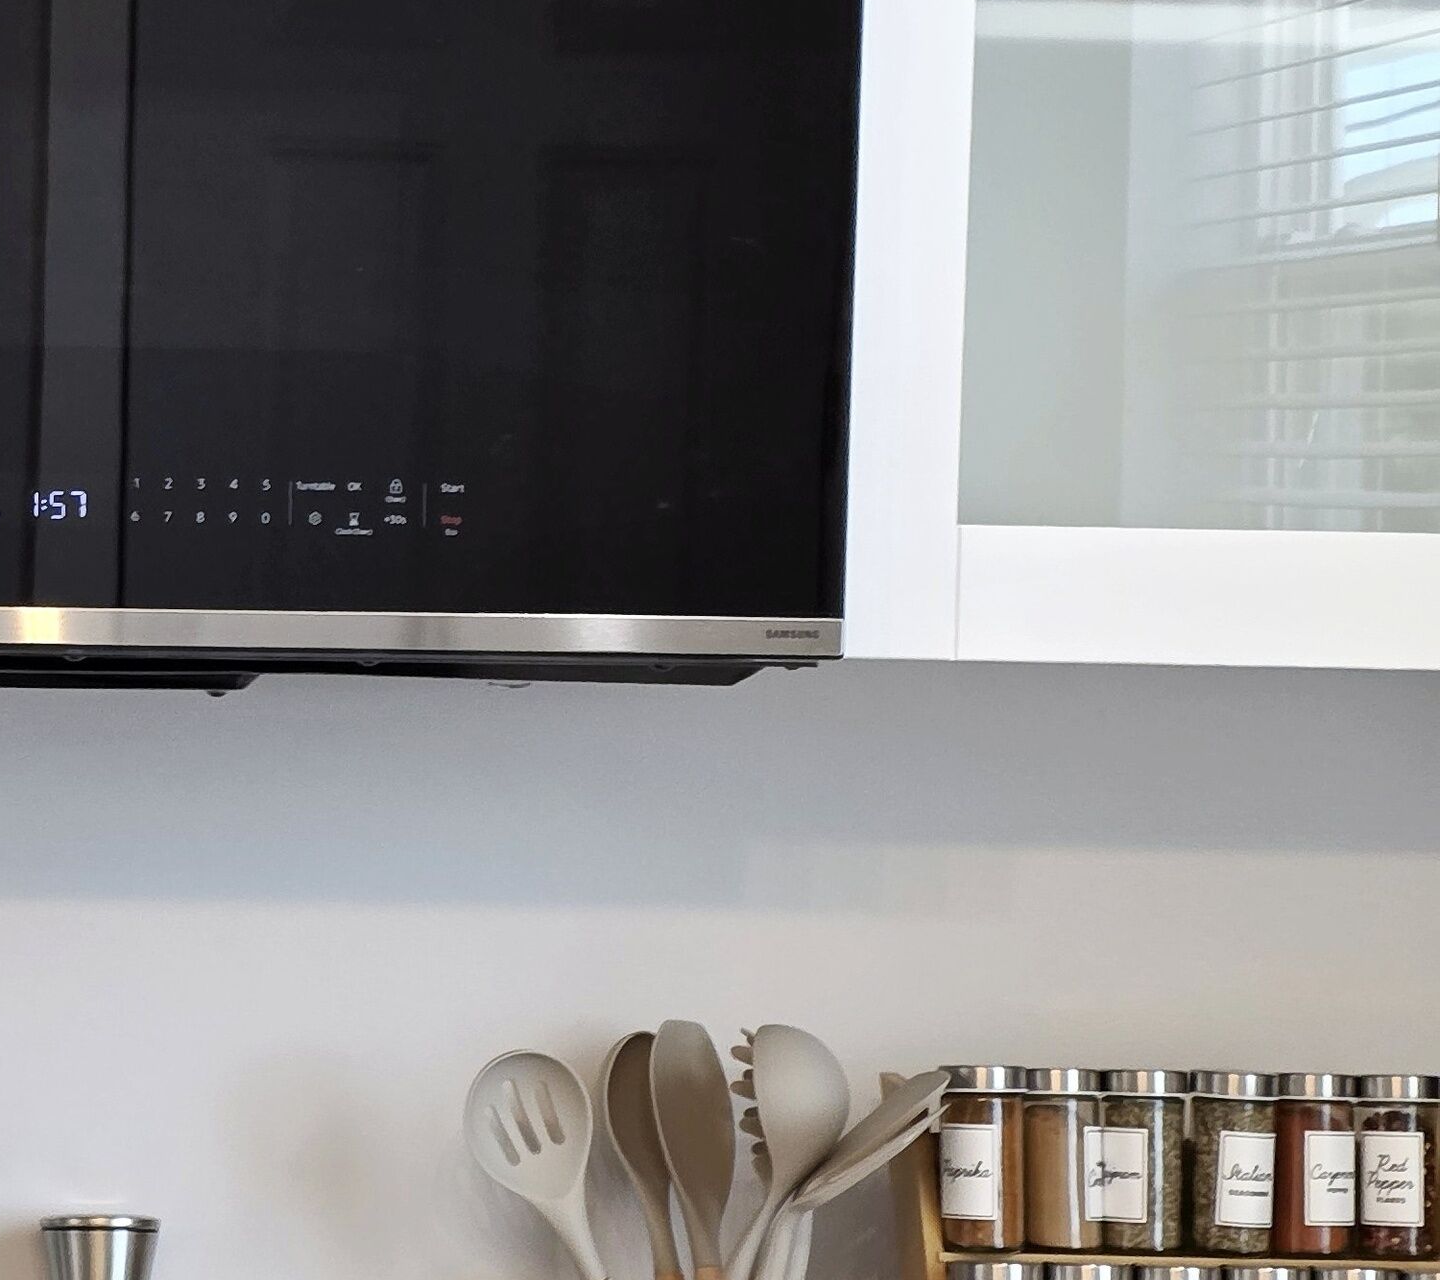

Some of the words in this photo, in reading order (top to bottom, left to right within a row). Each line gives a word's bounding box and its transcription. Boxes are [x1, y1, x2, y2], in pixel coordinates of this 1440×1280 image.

[133, 477, 140, 489] 1
[164, 477, 173, 490] 2
[196, 478, 206, 490] 3
[229, 478, 239, 489] 4
[262, 478, 271, 491] 5
[441, 483, 464, 493] Start
[33, 490, 87, 520] 1:57
[164, 510, 173, 522] 7
[196, 511, 205, 524] 8
[229, 511, 238, 523] 9
[261, 511, 271, 524] 0
[1377, 1154, 1409, 1173] Red
[1366, 1170, 1415, 1195] Pepper
